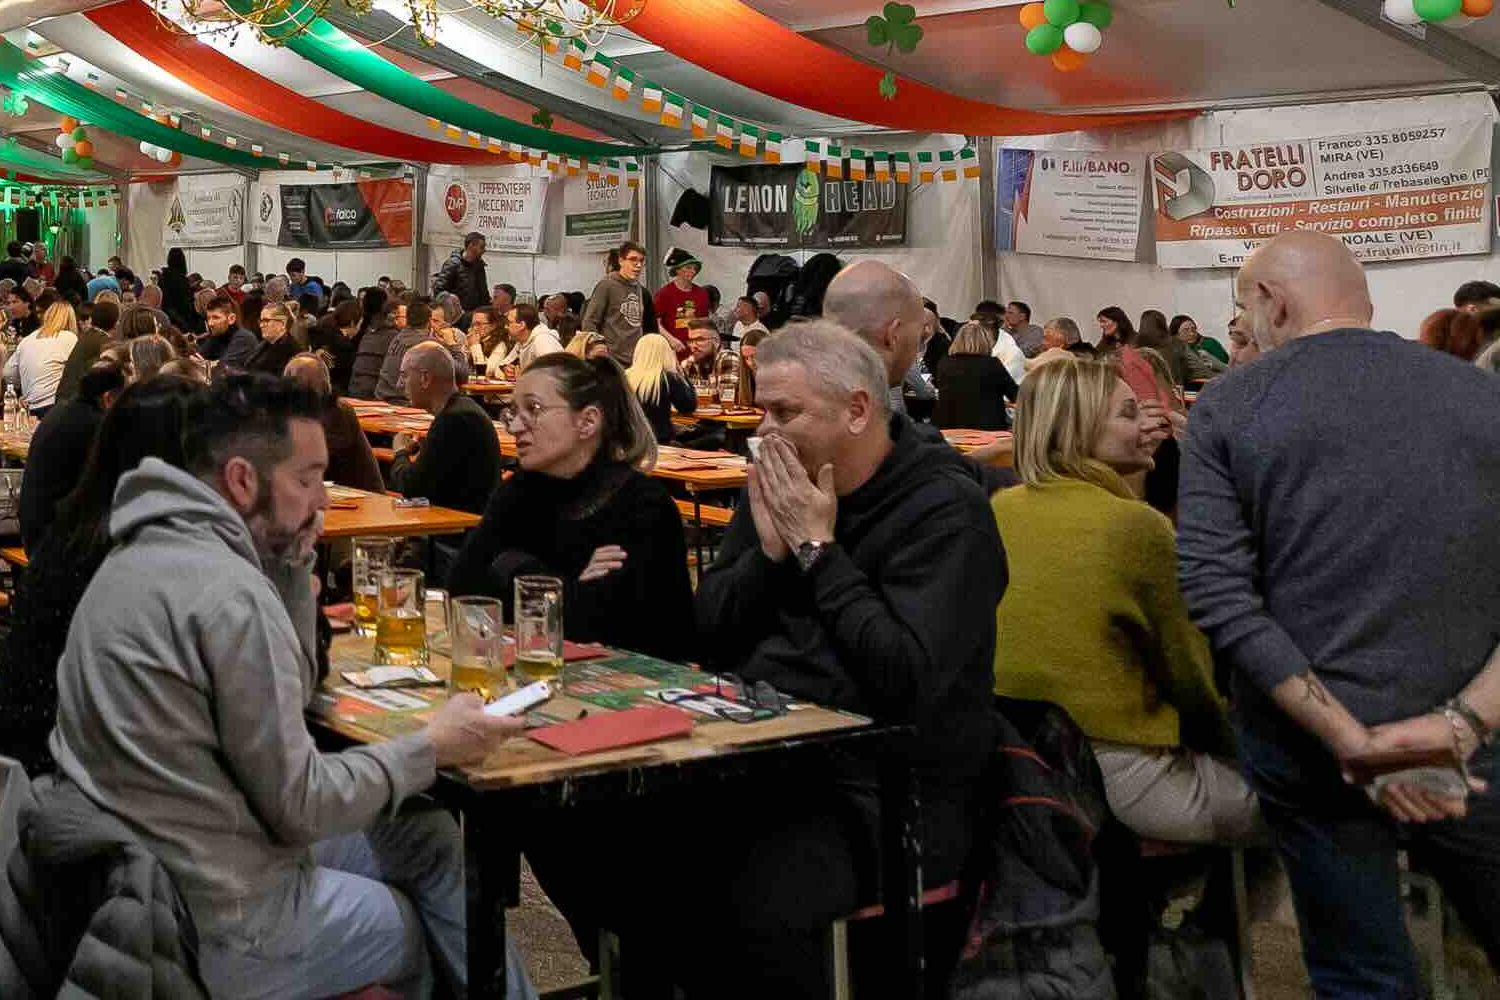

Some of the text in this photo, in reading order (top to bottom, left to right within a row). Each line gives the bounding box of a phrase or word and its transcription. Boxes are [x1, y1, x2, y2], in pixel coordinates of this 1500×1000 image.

[1318, 128, 1446, 151] Franco 335.8059257
[1210, 143, 1304, 171] FRATELLI
[1320, 149, 1384, 164] MIRA (VE)
[1237, 167, 1306, 192] DORO
[1323, 170, 1365, 182] Andrea
[1324, 183, 1366, 195] Silvelle
[1368, 181, 1379, 192] di
[1382, 171, 1468, 190] Trebaseleghe
[478, 199, 524, 213] MECCANICA
[723, 179, 896, 213] LEMON HEAD
[1214, 203, 1296, 220] Costruzioni
[1308, 197, 1370, 215] Restauri
[1385, 187, 1484, 209] Manutenzio
[1189, 223, 1247, 240] Ripasso
[1251, 221, 1280, 235] Tetti
[1294, 216, 1354, 233] Servizio
[1358, 212, 1438, 230] completo
[1342, 231, 1395, 247] NOALE
[1400, 229, 1433, 242] (VE)
[1218, 254, 1243, 264] E-m
